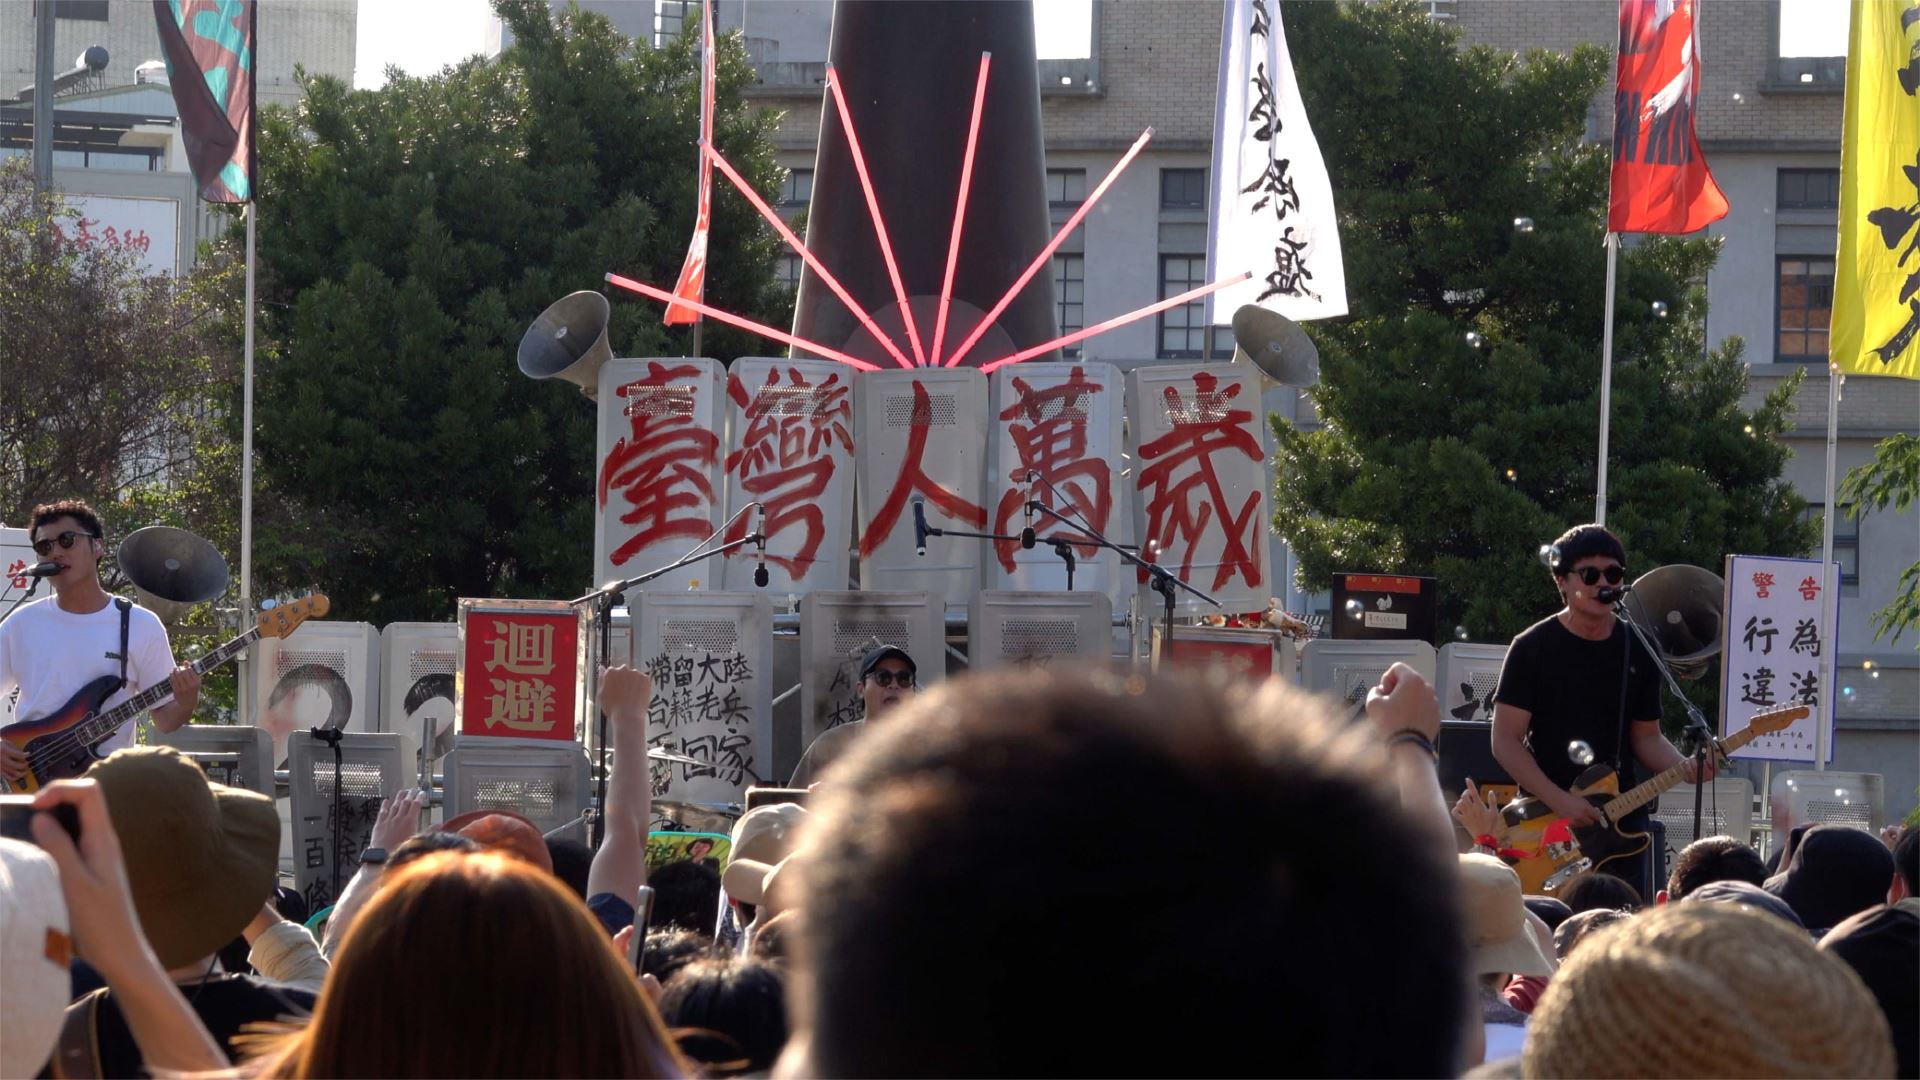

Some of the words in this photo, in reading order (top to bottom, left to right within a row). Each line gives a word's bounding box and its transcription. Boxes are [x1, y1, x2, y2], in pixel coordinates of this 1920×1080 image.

[1751, 572, 1822, 601] 警告
[1743, 615, 1821, 658] 行為
[1741, 666, 1819, 708] 違法
